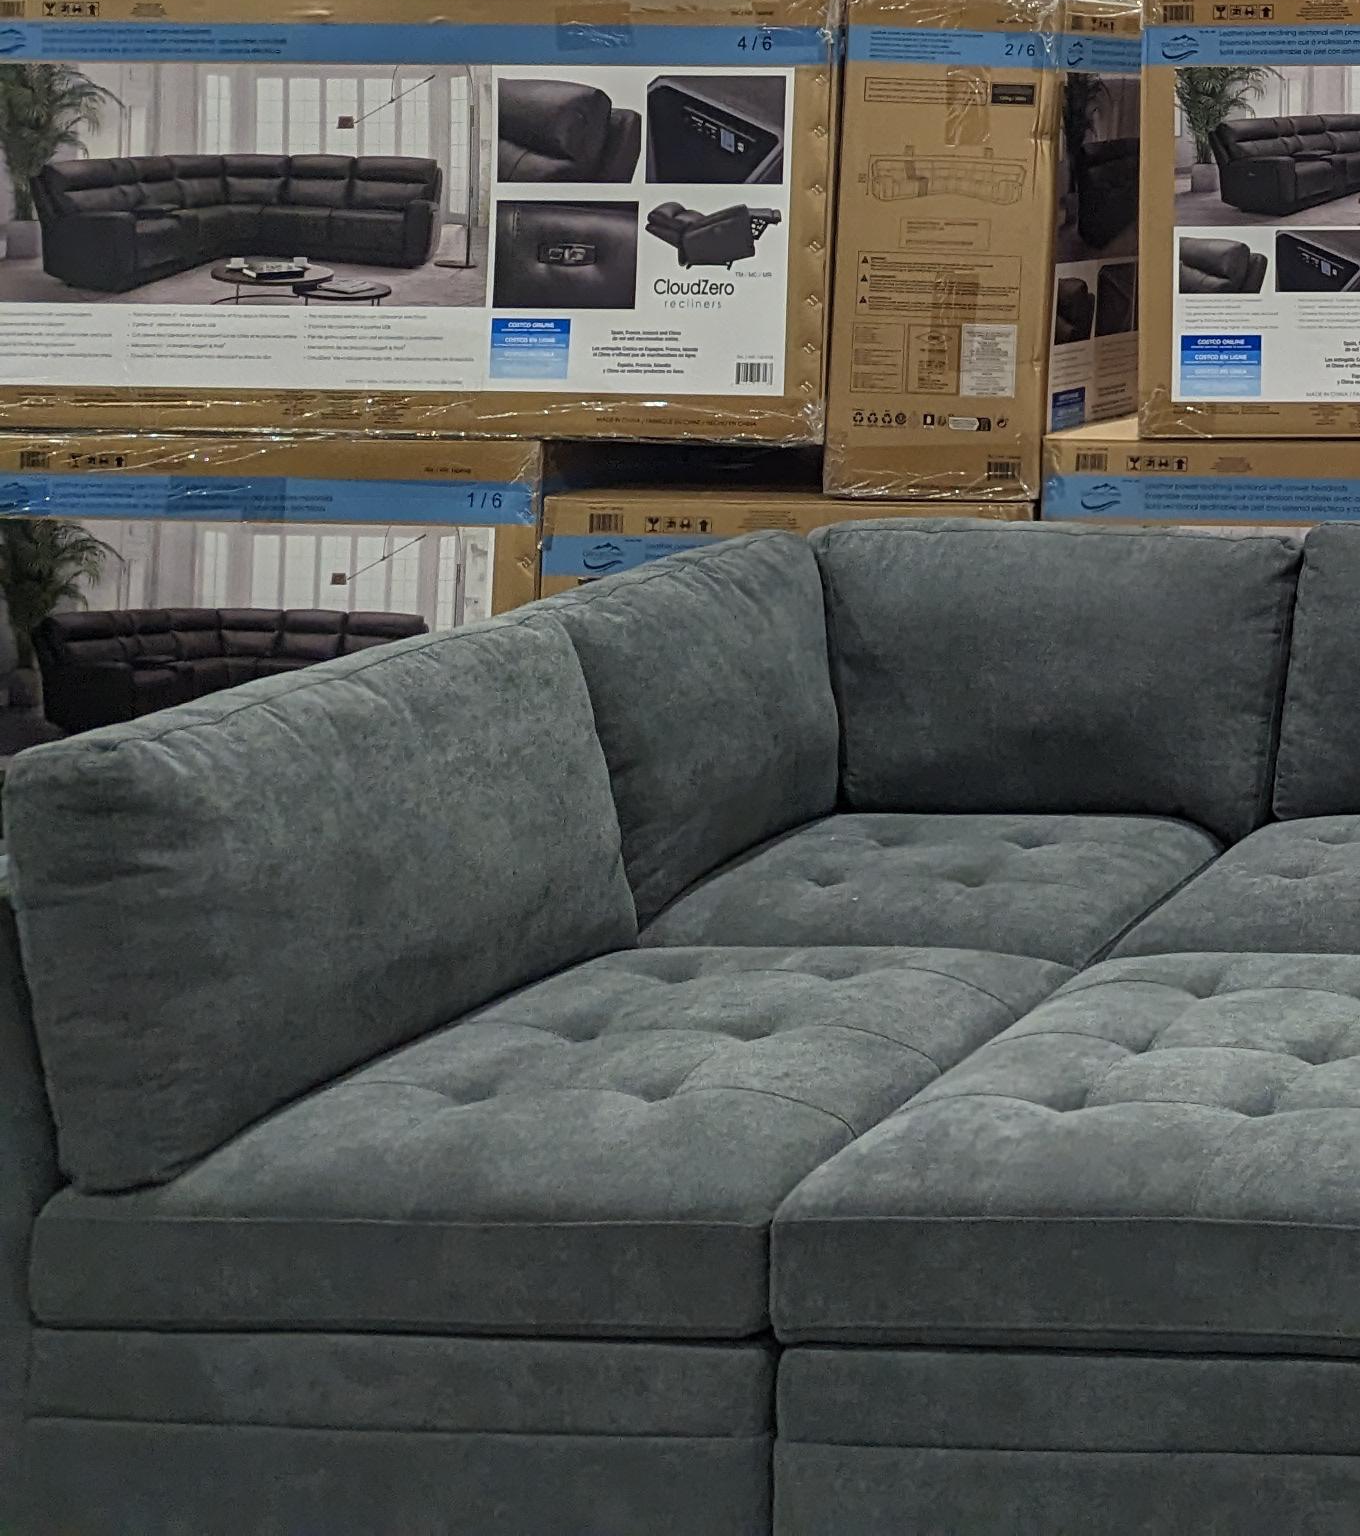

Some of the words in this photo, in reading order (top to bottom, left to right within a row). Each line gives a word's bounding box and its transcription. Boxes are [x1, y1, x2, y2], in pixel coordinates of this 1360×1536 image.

[738, 36, 747, 50] 4
[762, 36, 772, 50] 6
[654, 278, 735, 296] CloudZero
[664, 299, 722, 309] recliners
